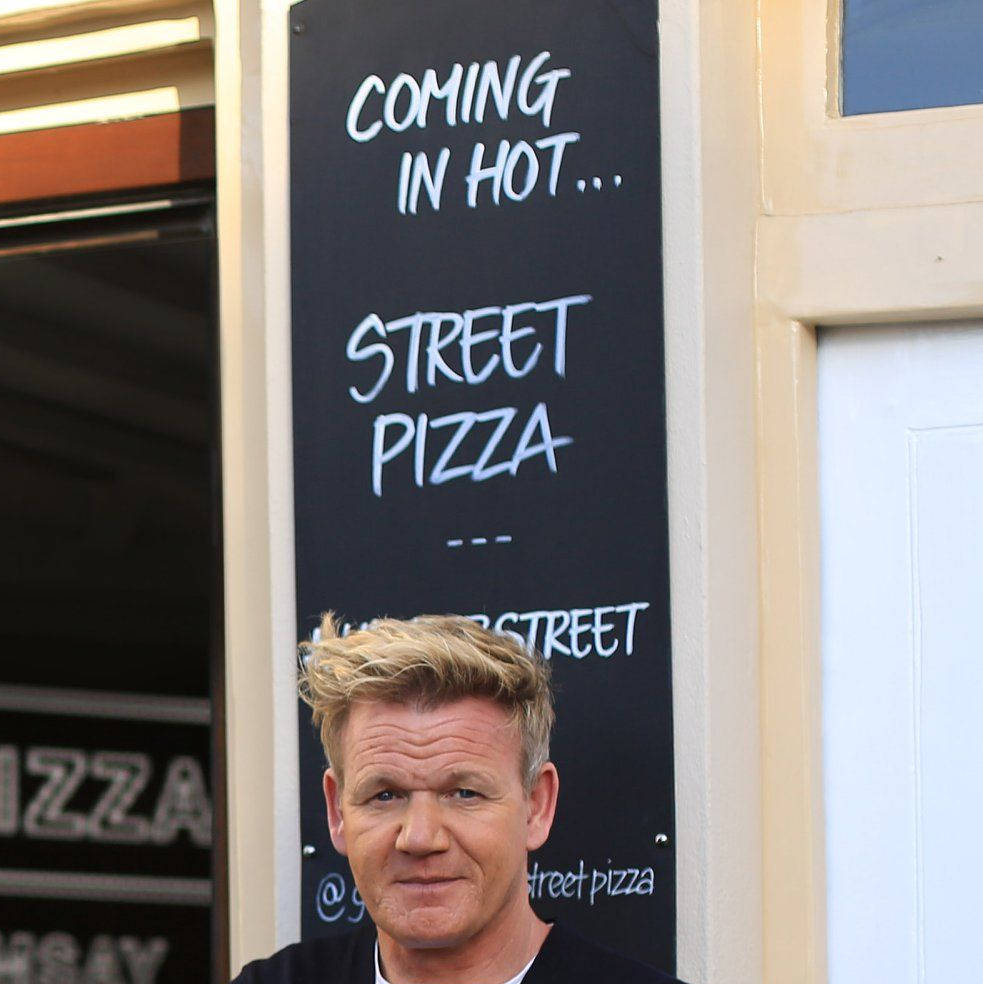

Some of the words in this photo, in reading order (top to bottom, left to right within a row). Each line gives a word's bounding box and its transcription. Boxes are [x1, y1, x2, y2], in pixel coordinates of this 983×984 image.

[346, 50, 572, 143] COMING
[397, 146, 450, 215] IN
[346, 295, 593, 404] STREET
[372, 402, 575, 498] PIZZA
